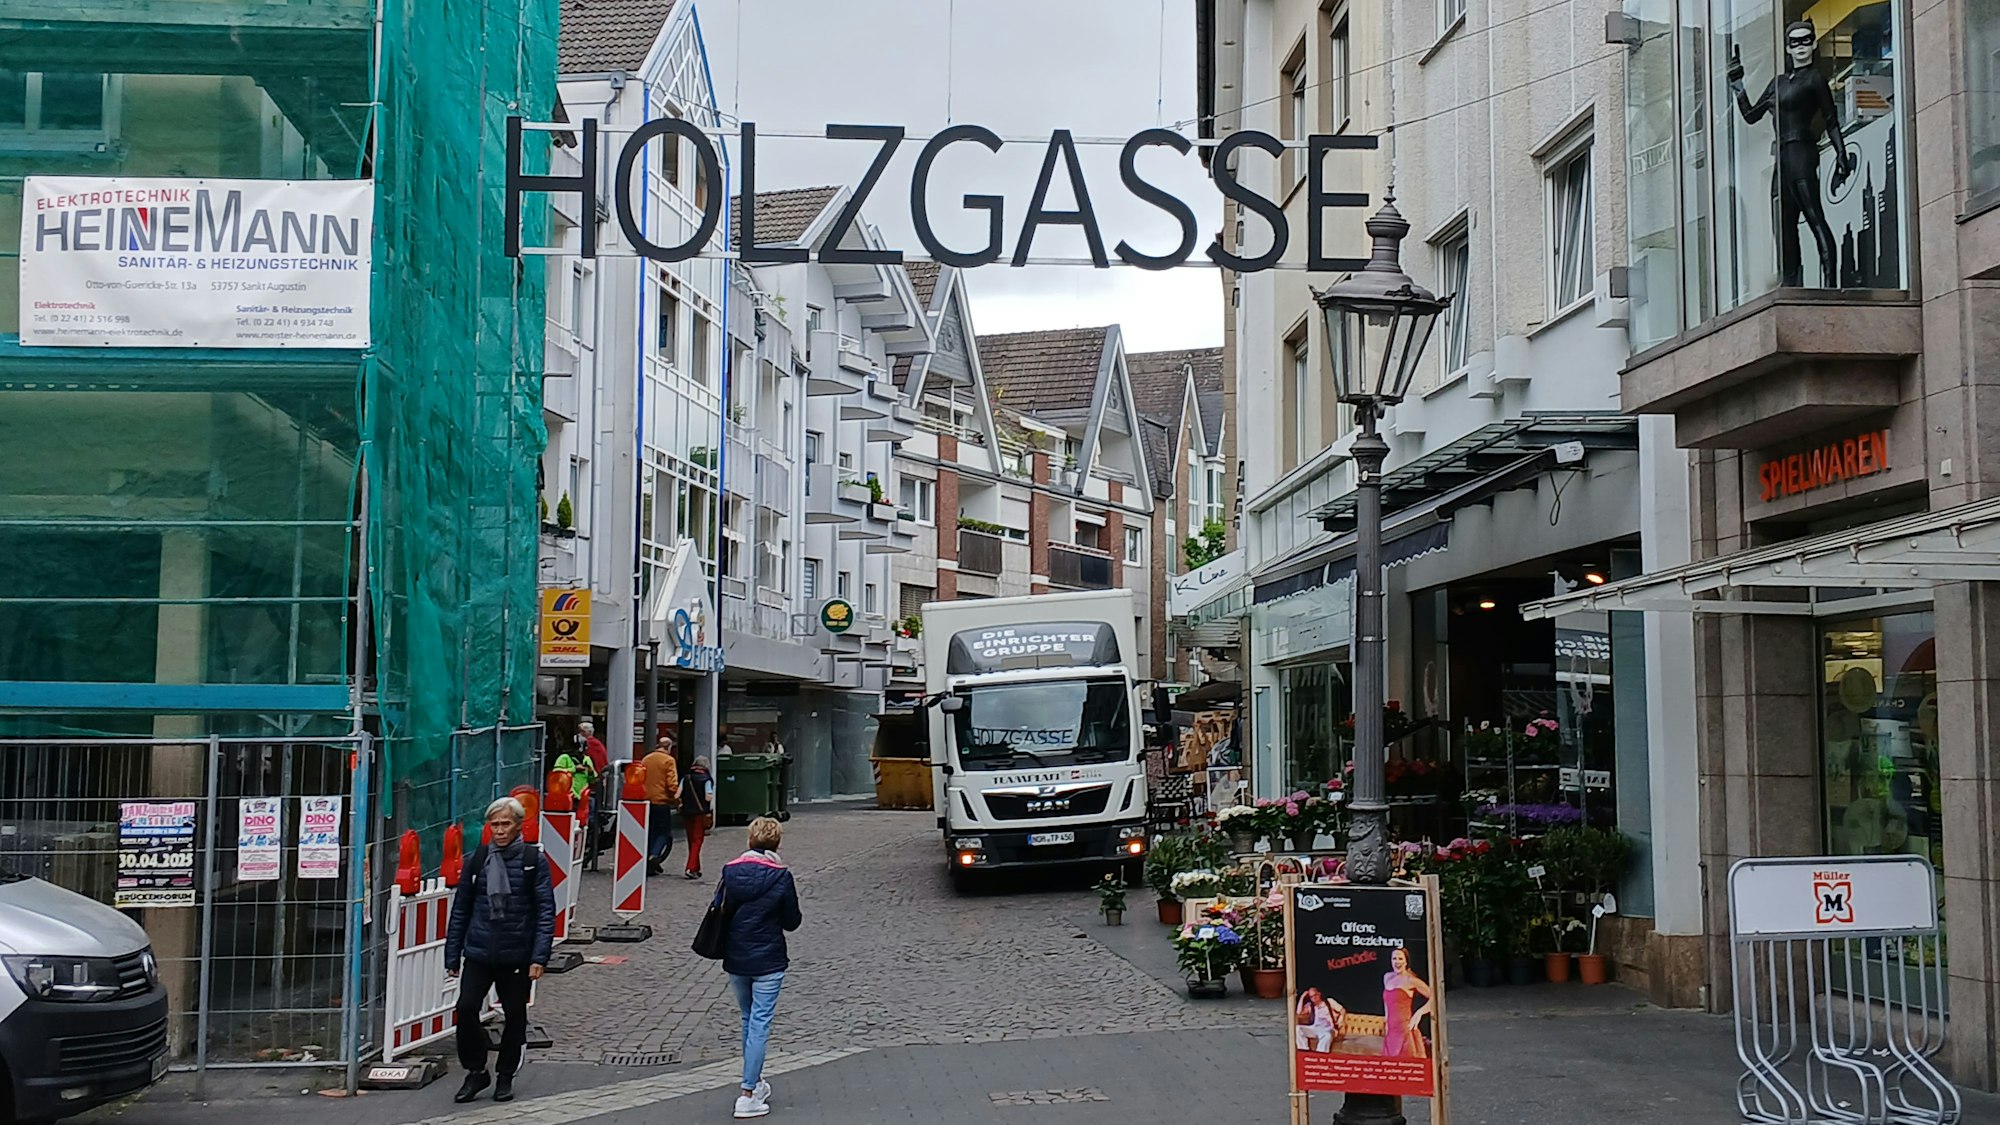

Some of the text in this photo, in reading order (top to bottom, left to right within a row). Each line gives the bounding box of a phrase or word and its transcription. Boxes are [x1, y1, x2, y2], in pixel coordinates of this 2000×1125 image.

[37, 188, 191, 210] ELEKTROTECHNIK
[505, 117, 1378, 272] HOLZGASSE
[36, 189, 359, 255] HEINEMANN
[118, 255, 359, 271] SANITÄR- & HEIZUNGSTECHNIK
[211, 281, 239, 291] 53757
[241, 281, 266, 291] Sankt
[267, 282, 307, 293] Augustin
[34, 301, 96, 310] Elektrotechnik
[281, 306, 353, 316] Heizungstechnik
[264, 319, 275, 327] 22
[293, 319, 298, 327] 4
[1760, 431, 1890, 501] SPIELWAREN
[982, 629, 1016, 640] DIE
[973, 634, 1096, 650] EINRICHTER
[983, 643, 1065, 657] GRUPPE
[1026, 800, 1070, 813] MAN
[244, 816, 276, 826] DINO
[305, 814, 336, 824] DINO
[118, 853, 193, 869] 30.04.2025
[1813, 870, 1850, 881] Müller
[1824, 894, 1844, 912] M
[1341, 922, 1376, 933] Offene
[1352, 935, 1404, 949] Beziehung
[1327, 950, 1377, 970] Komödie
